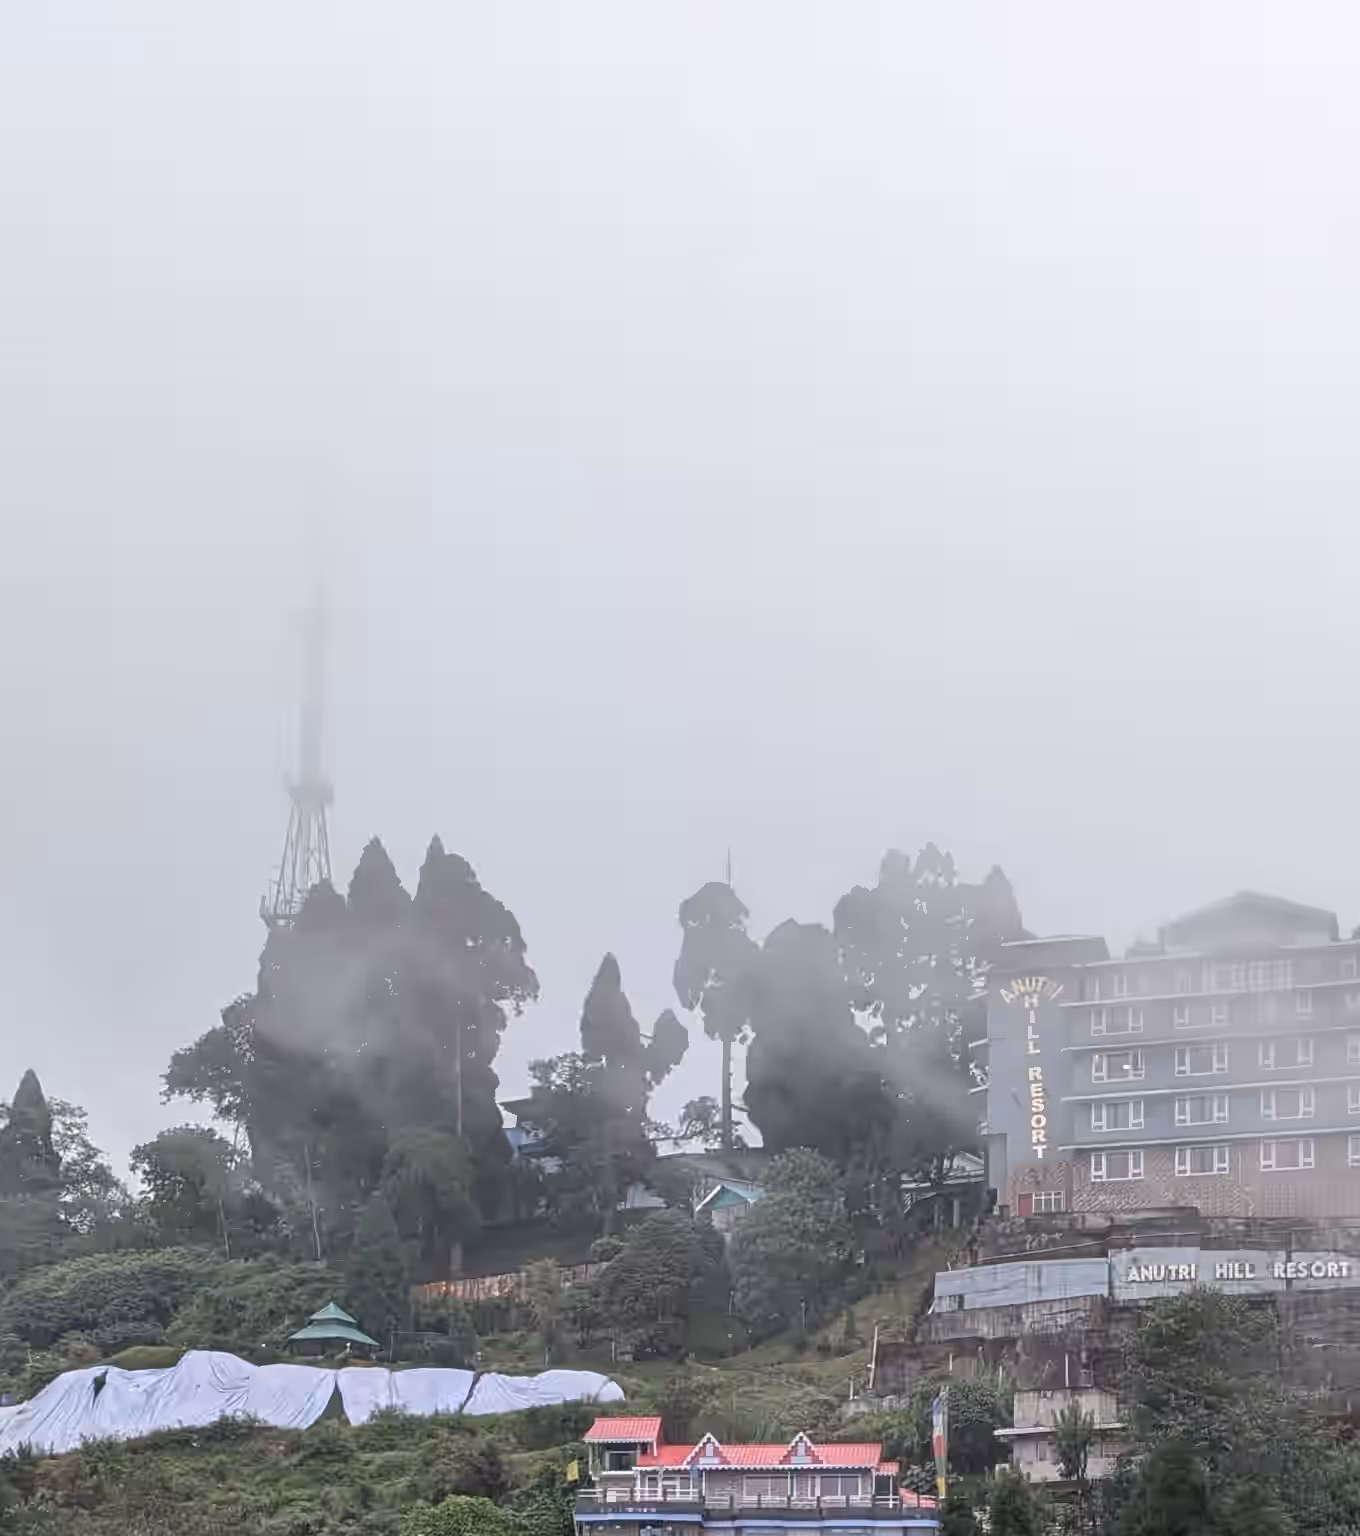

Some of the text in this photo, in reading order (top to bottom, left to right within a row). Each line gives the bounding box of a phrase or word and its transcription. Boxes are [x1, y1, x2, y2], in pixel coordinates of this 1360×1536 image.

[1024, 994, 1047, 1158] HILL RESORT
[1127, 1261, 1350, 1281] ANUTRI HILL RESORT
